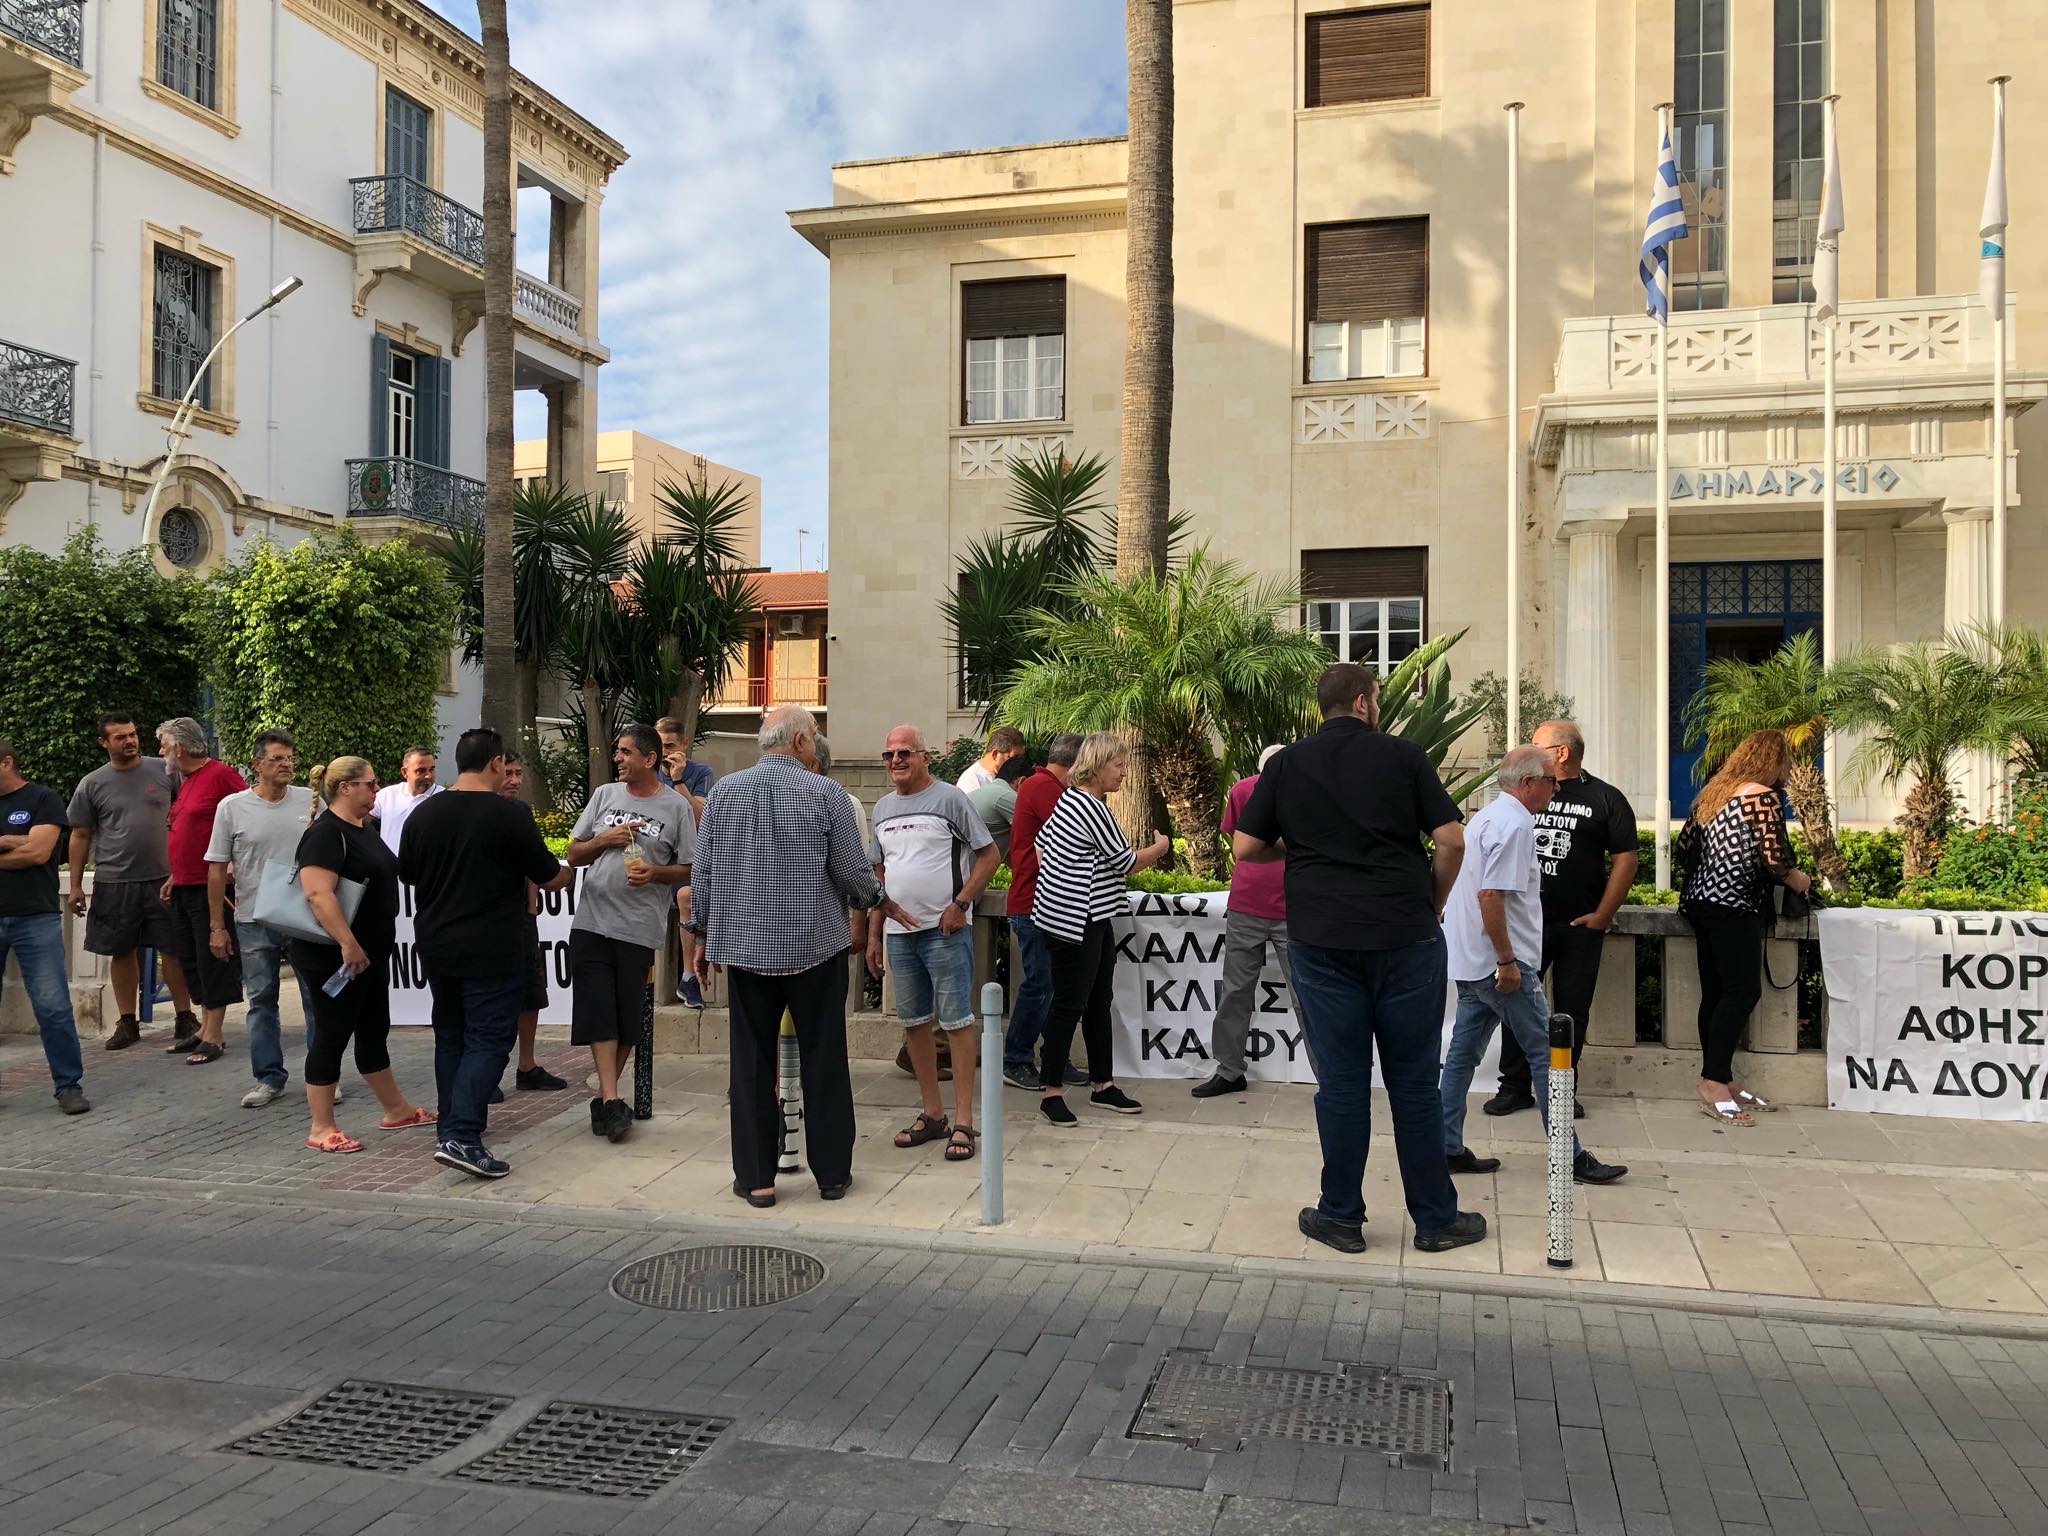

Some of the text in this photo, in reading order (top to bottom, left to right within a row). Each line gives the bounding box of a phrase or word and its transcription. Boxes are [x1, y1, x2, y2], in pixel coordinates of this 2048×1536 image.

[1670, 463, 1901, 500] ΔΗΜΑΡΧΕΙΟ
[1563, 803, 1592, 817] ΔΗΜΟ
[1897, 1005, 2048, 1046] ΑΦΗΣ
[1845, 1055, 2048, 1100] ΝΑ ΔΟΥ
